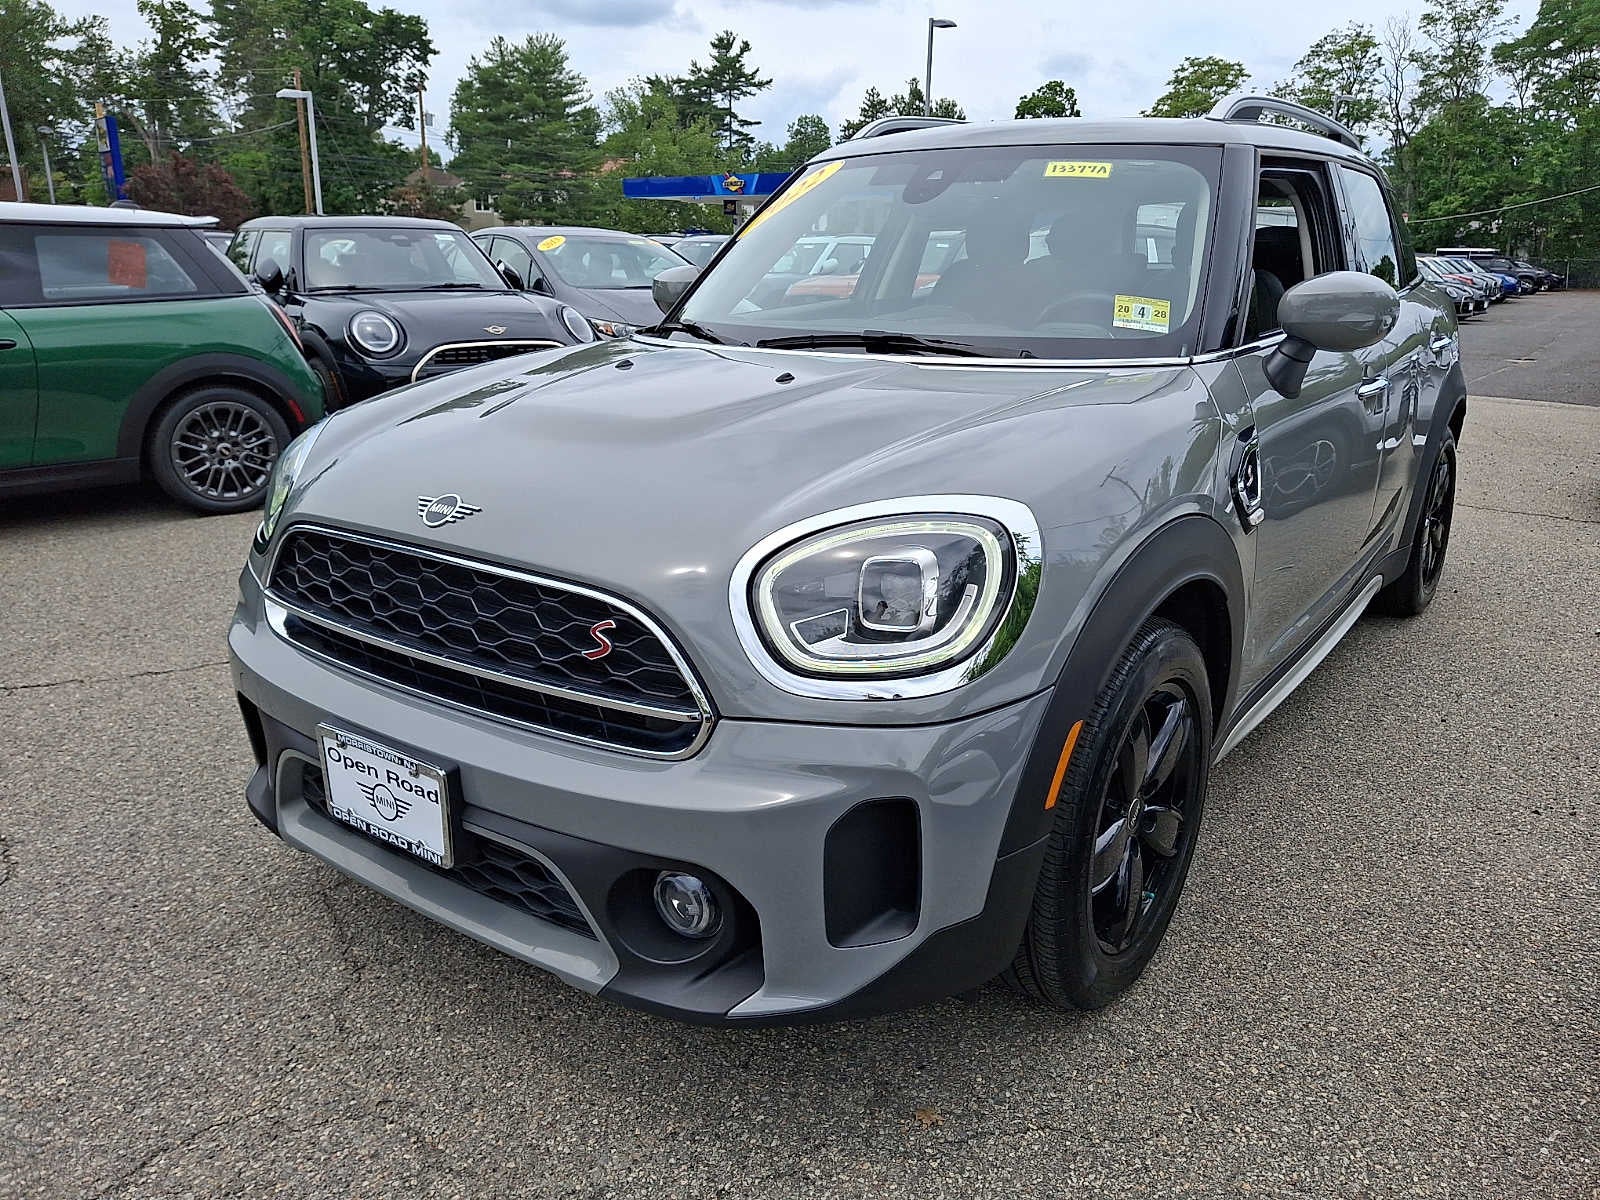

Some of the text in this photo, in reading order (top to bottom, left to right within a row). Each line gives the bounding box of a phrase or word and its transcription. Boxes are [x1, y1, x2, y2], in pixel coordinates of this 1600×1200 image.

[1117, 304, 1130, 314] 20
[1138, 306, 1146, 319] 4
[1153, 309, 1167, 319] 28
[429, 502, 455, 516] MINI
[581, 619, 617, 661] S
[403, 760, 418, 771] NJ
[327, 746, 440, 805] Open Road
[375, 794, 395, 811] MINI
[332, 806, 442, 866] OPEN ROAD MINI
